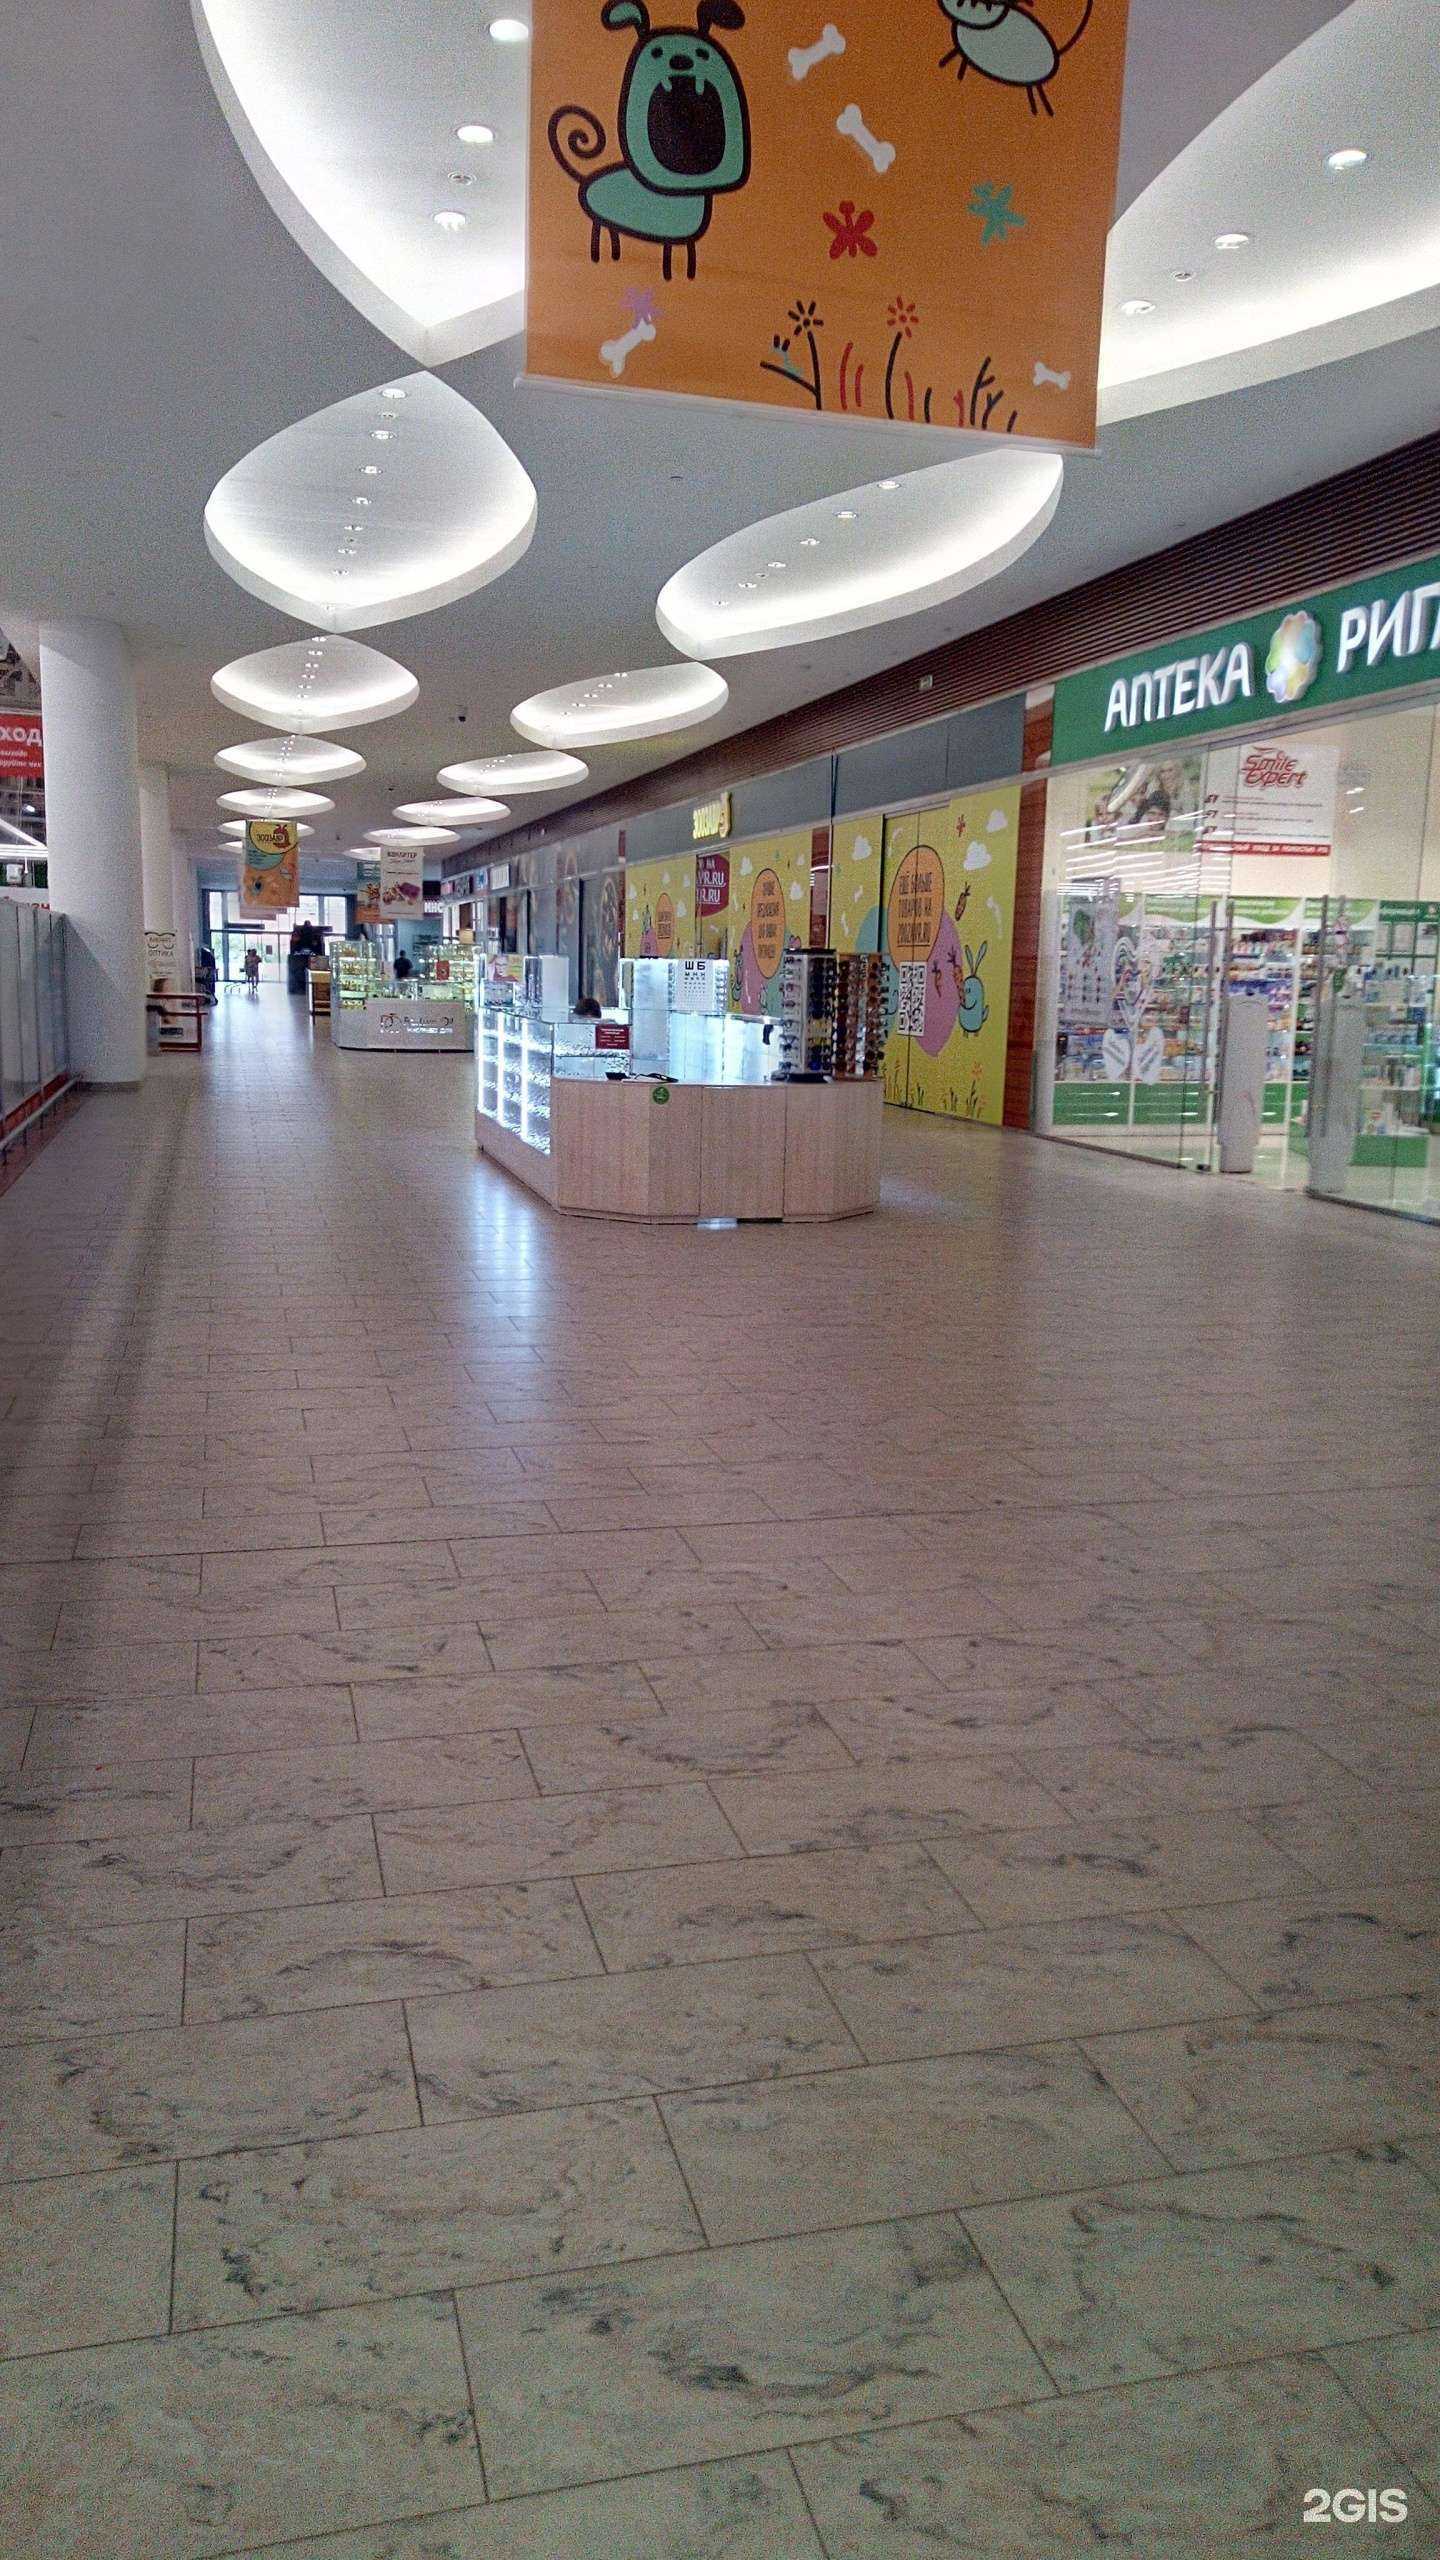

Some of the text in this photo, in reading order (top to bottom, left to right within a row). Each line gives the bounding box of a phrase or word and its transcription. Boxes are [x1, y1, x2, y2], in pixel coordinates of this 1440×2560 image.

[1104, 642, 1254, 732] АПТЕКА
[0, 726, 42, 747] ХОД
[1246, 750, 1298, 771] Smile
[1242, 768, 1308, 786] Expert
